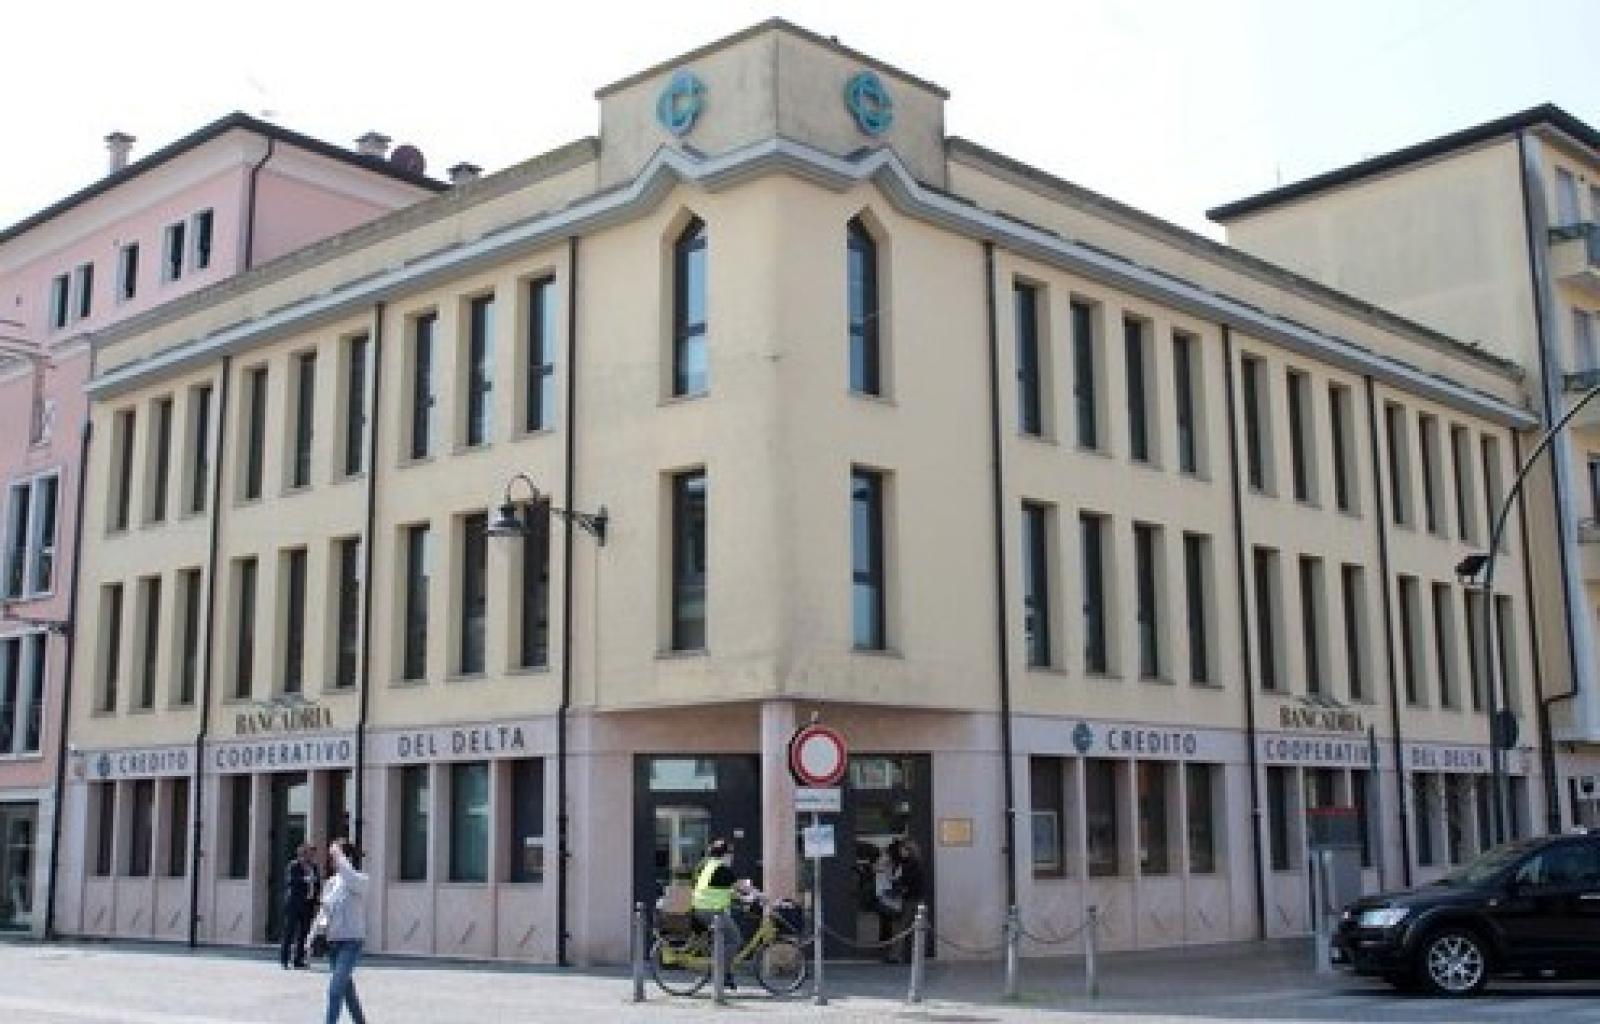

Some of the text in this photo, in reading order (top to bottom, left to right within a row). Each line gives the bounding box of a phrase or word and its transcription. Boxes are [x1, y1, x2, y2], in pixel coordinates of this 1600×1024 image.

[118, 727, 525, 774] CREDITO COOPERATIVO DEL DELTA
[1107, 728, 1484, 768] CREDITO COOPERATIV DEL DELTA
